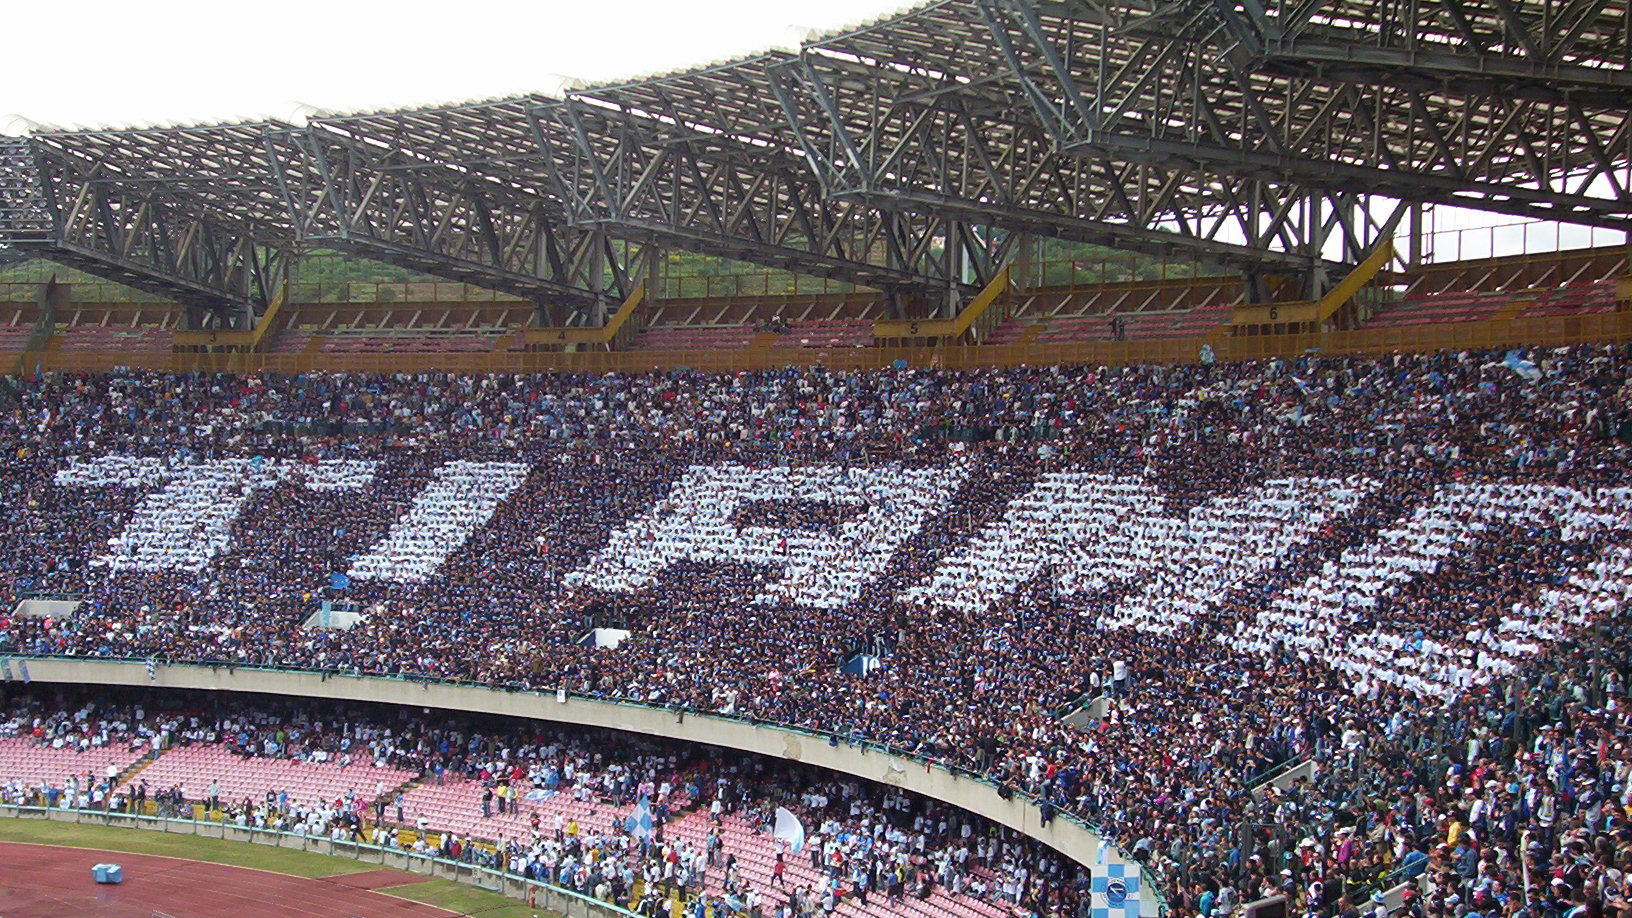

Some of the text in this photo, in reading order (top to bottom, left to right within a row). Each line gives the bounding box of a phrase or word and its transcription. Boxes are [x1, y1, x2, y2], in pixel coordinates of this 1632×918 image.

[1270, 307, 1278, 320] 6
[910, 323, 918, 334] 5
[54, 455, 1632, 704] TI AMO
